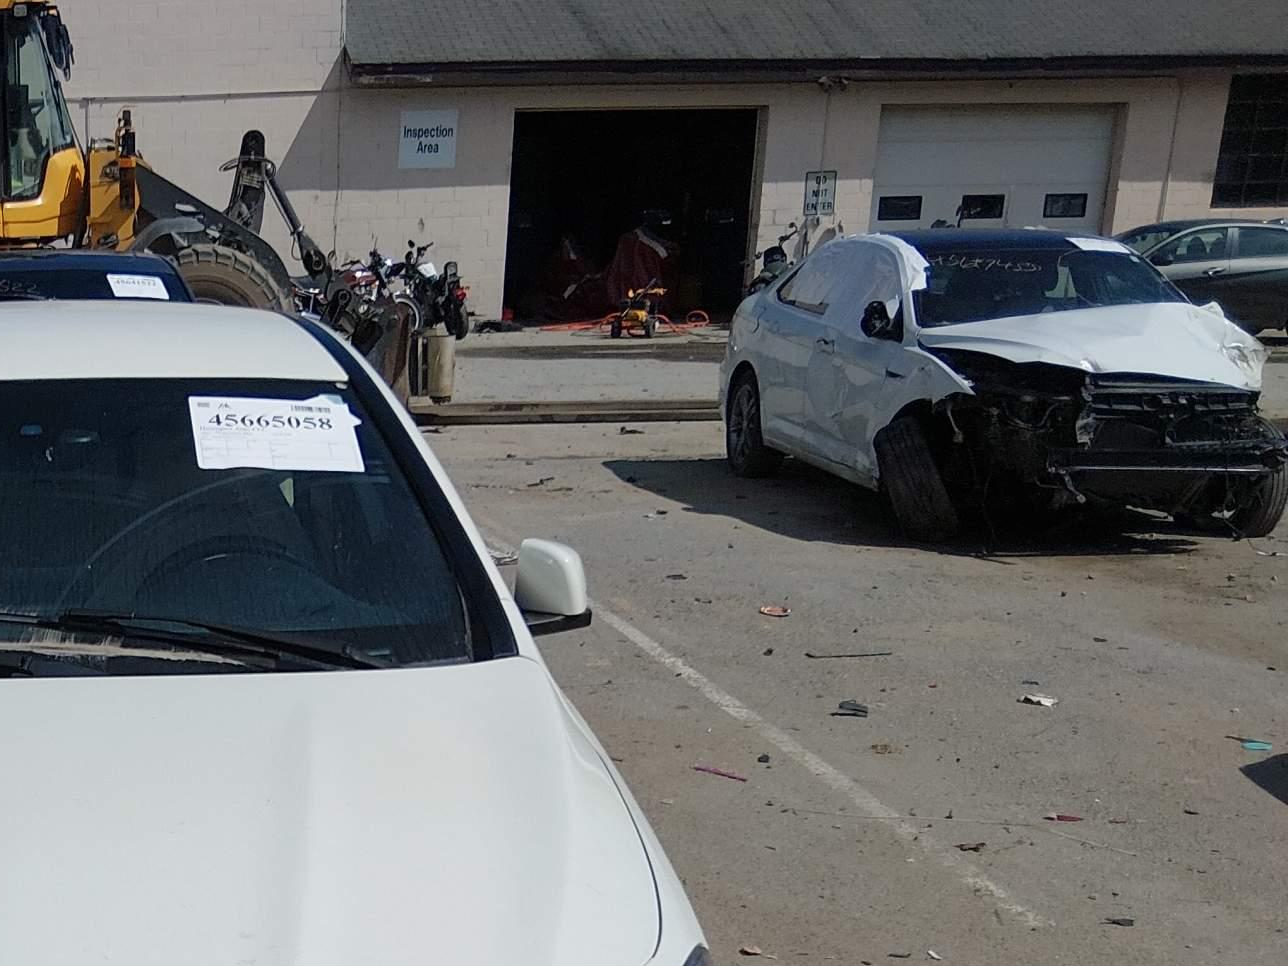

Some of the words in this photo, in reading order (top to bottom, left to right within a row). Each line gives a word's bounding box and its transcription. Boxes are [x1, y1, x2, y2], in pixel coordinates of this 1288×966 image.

[403, 125, 454, 140] Inspection
[416, 141, 439, 154] Area
[815, 175, 827, 185] DO
[208, 413, 333, 431] 45665058
